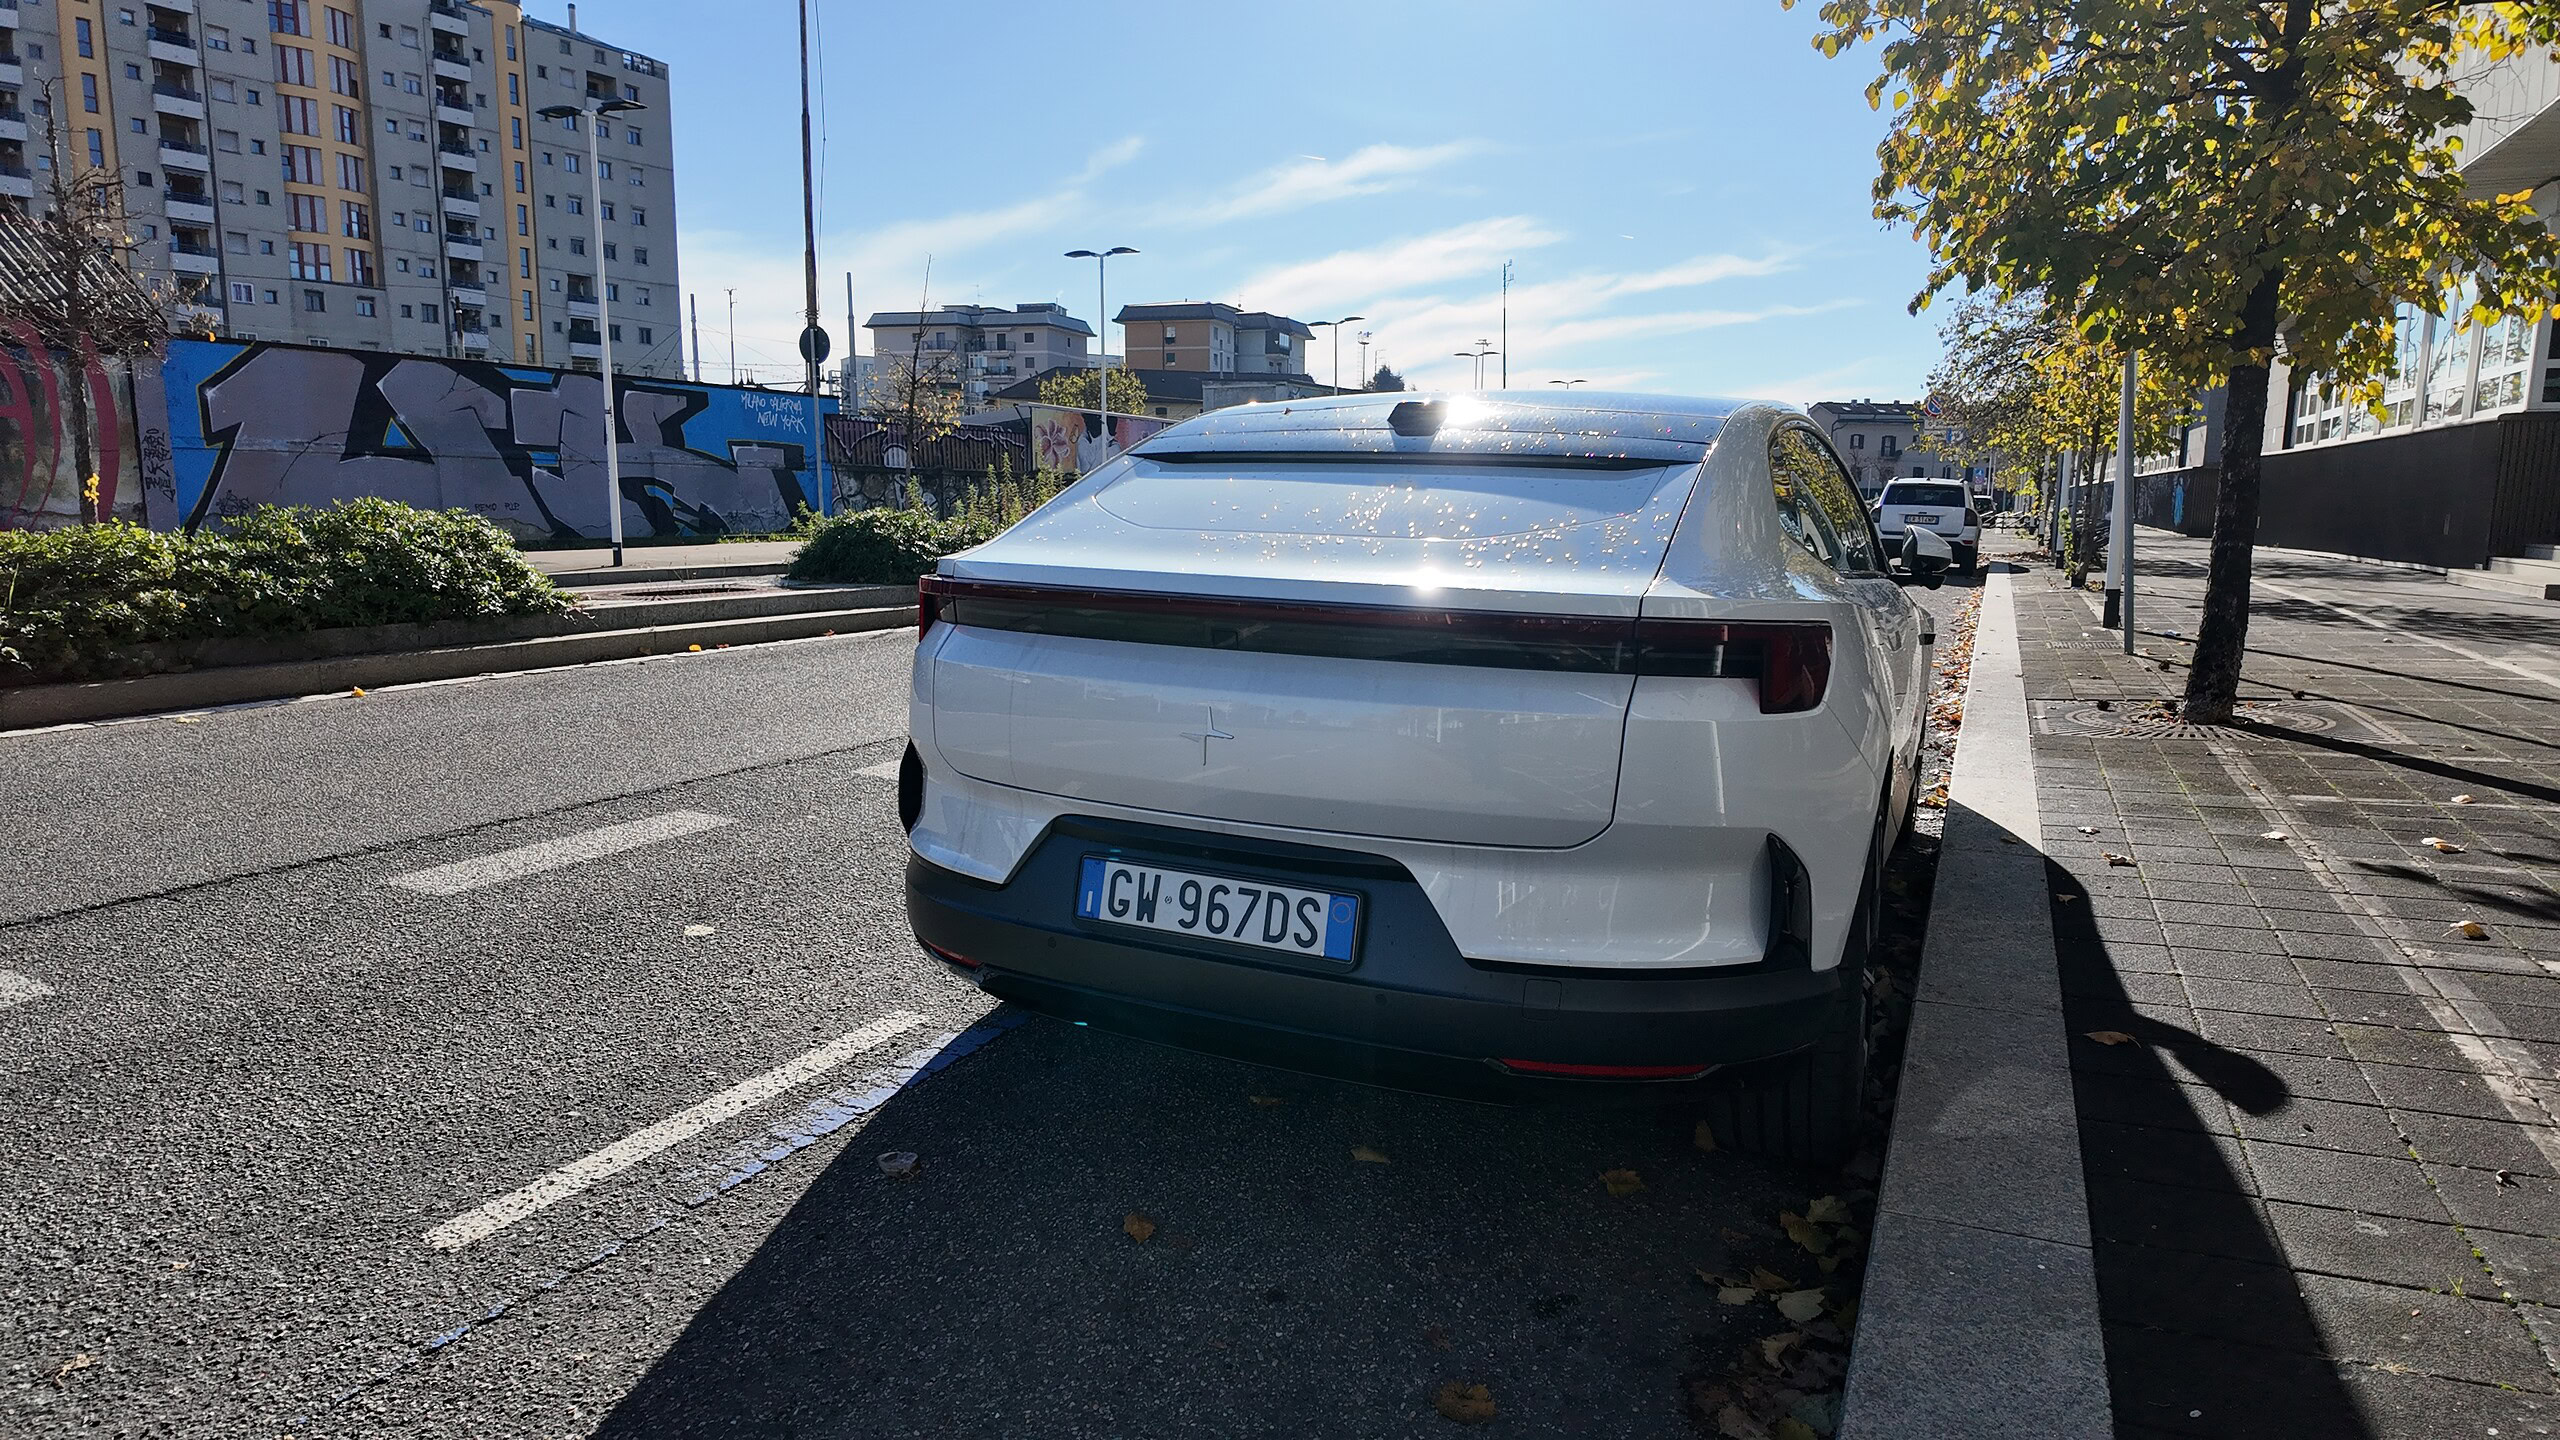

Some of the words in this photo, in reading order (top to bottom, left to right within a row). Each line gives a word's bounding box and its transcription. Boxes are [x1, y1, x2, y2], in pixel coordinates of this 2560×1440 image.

[758, 411, 778, 427] NEW
[781, 414, 807, 434] YORK
[1107, 869, 1162, 924] GW
[1177, 879, 1322, 949] 967DS
